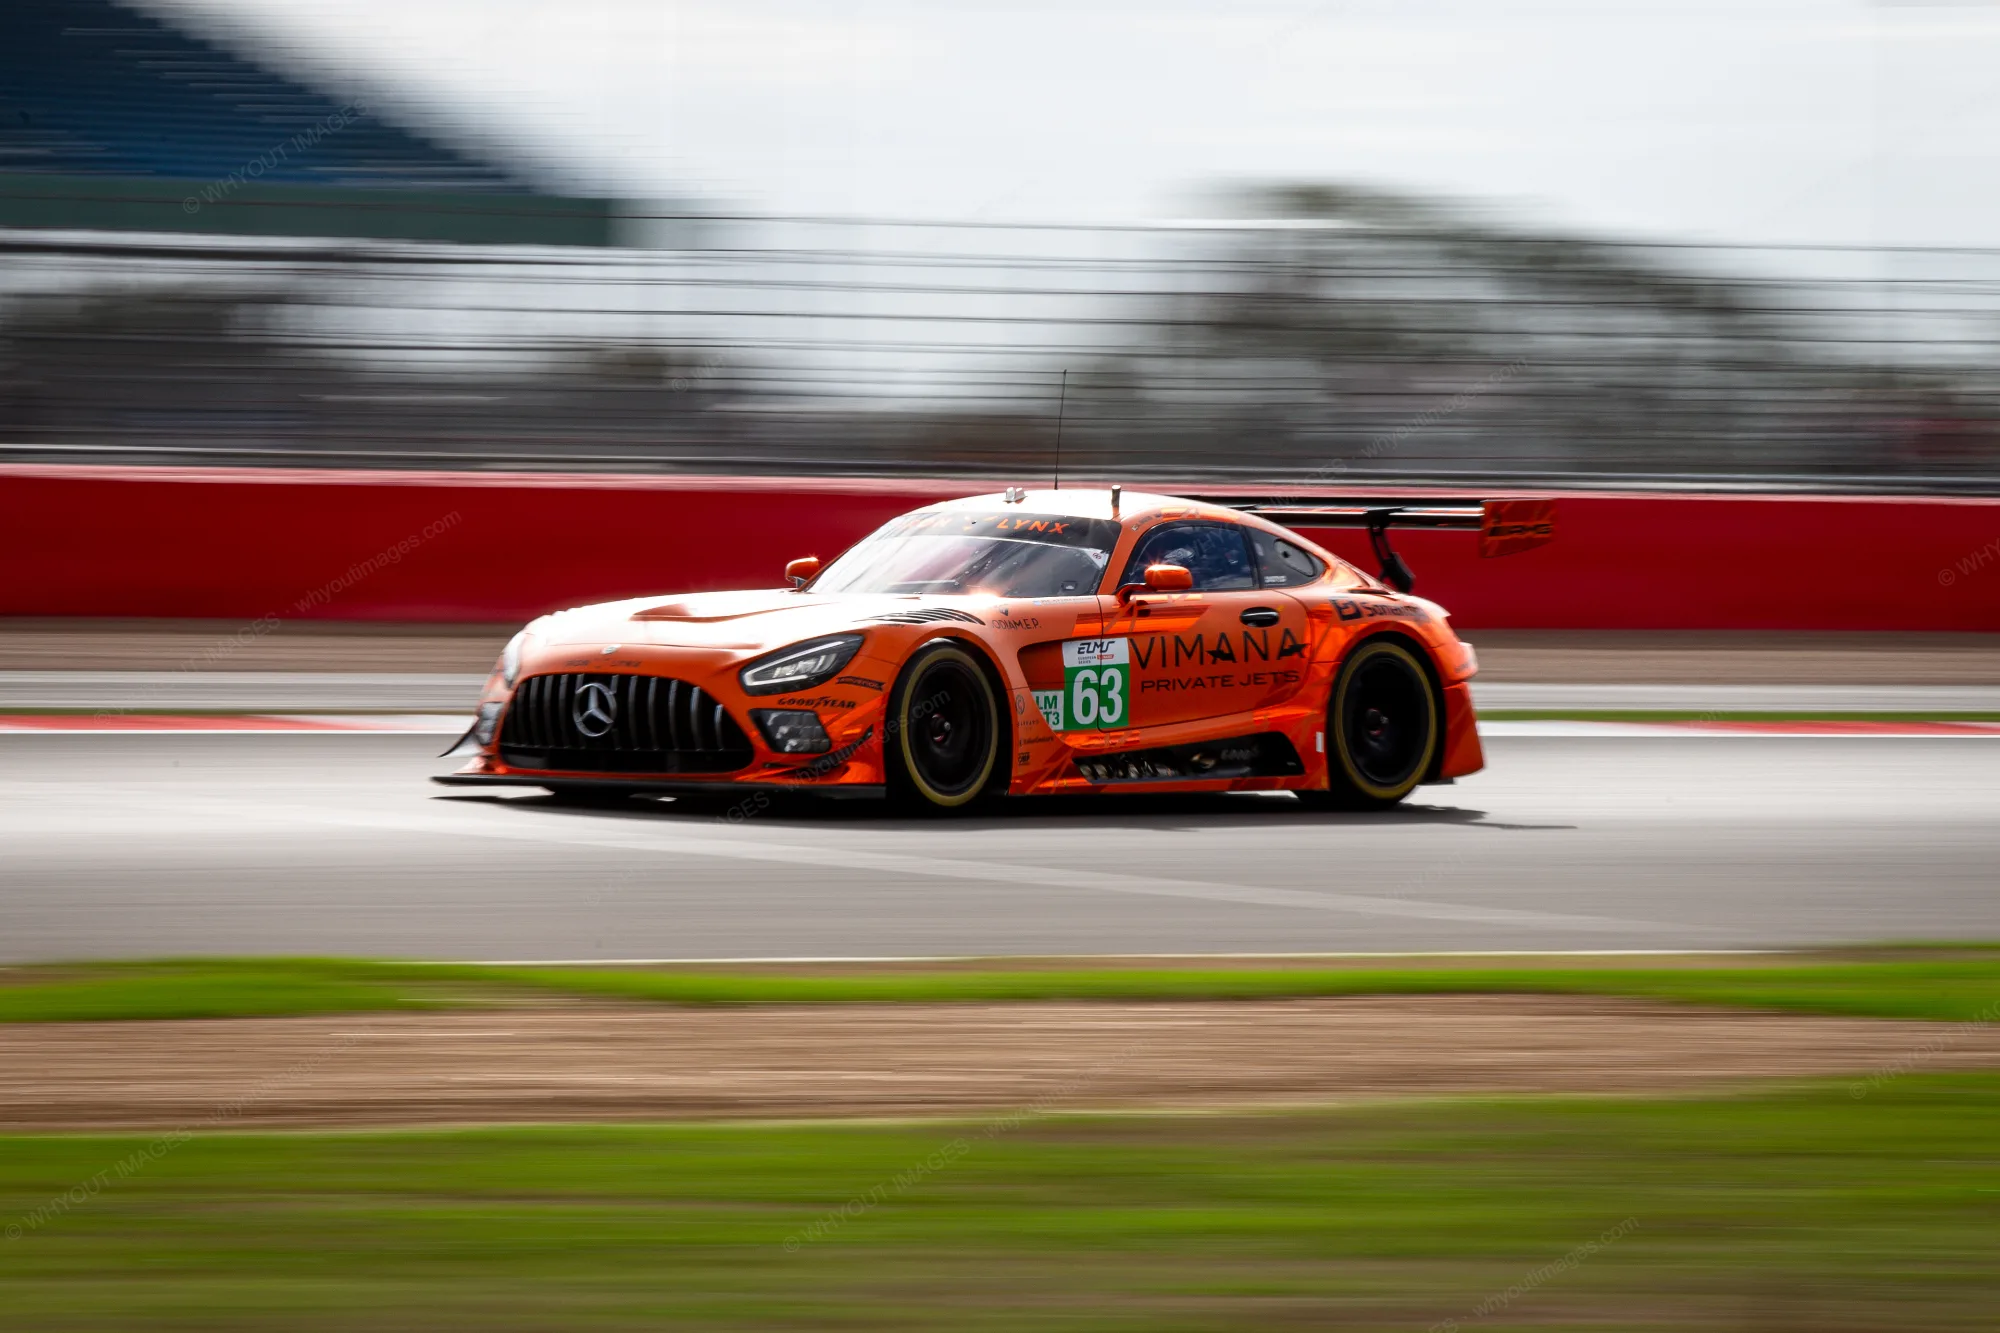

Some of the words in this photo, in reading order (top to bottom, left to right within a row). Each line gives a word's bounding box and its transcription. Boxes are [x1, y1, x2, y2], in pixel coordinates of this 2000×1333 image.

[996, 518, 1070, 534] LYNX
[1077, 641, 1115, 654] ELMS
[1130, 628, 1308, 670] VIMANA
[1141, 674, 1234, 693] PRIVATE
[1239, 670, 1299, 687] JETS
[1036, 695, 1058, 710] LM
[1073, 668, 1122, 725] 63
